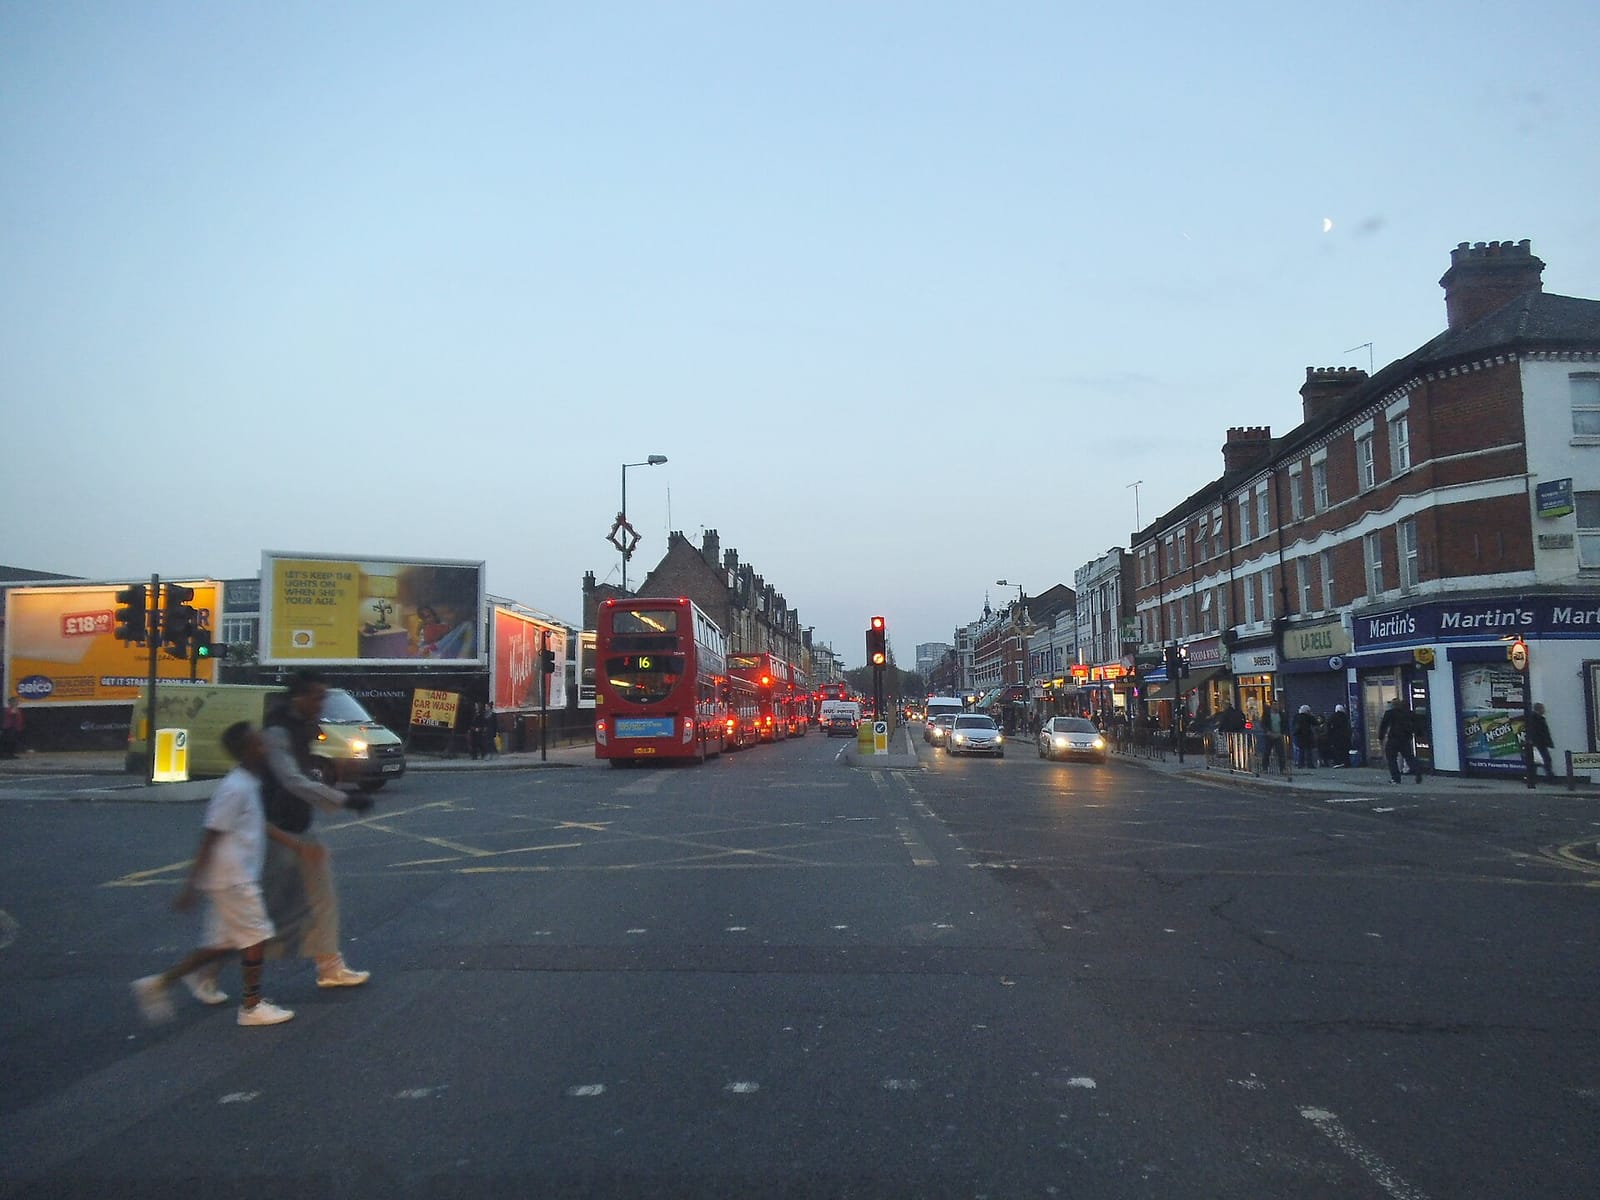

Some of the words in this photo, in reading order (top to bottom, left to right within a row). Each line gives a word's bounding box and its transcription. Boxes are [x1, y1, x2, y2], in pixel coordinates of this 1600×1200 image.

[310, 571, 334, 580] KEEP
[320, 581, 337, 589] ON
[1370, 613, 1416, 638] Martin's
[1440, 609, 1534, 629] Martin's
[639, 656, 650, 669] 16
[414, 699, 431, 709] CAR
[432, 700, 456, 712] WASH
